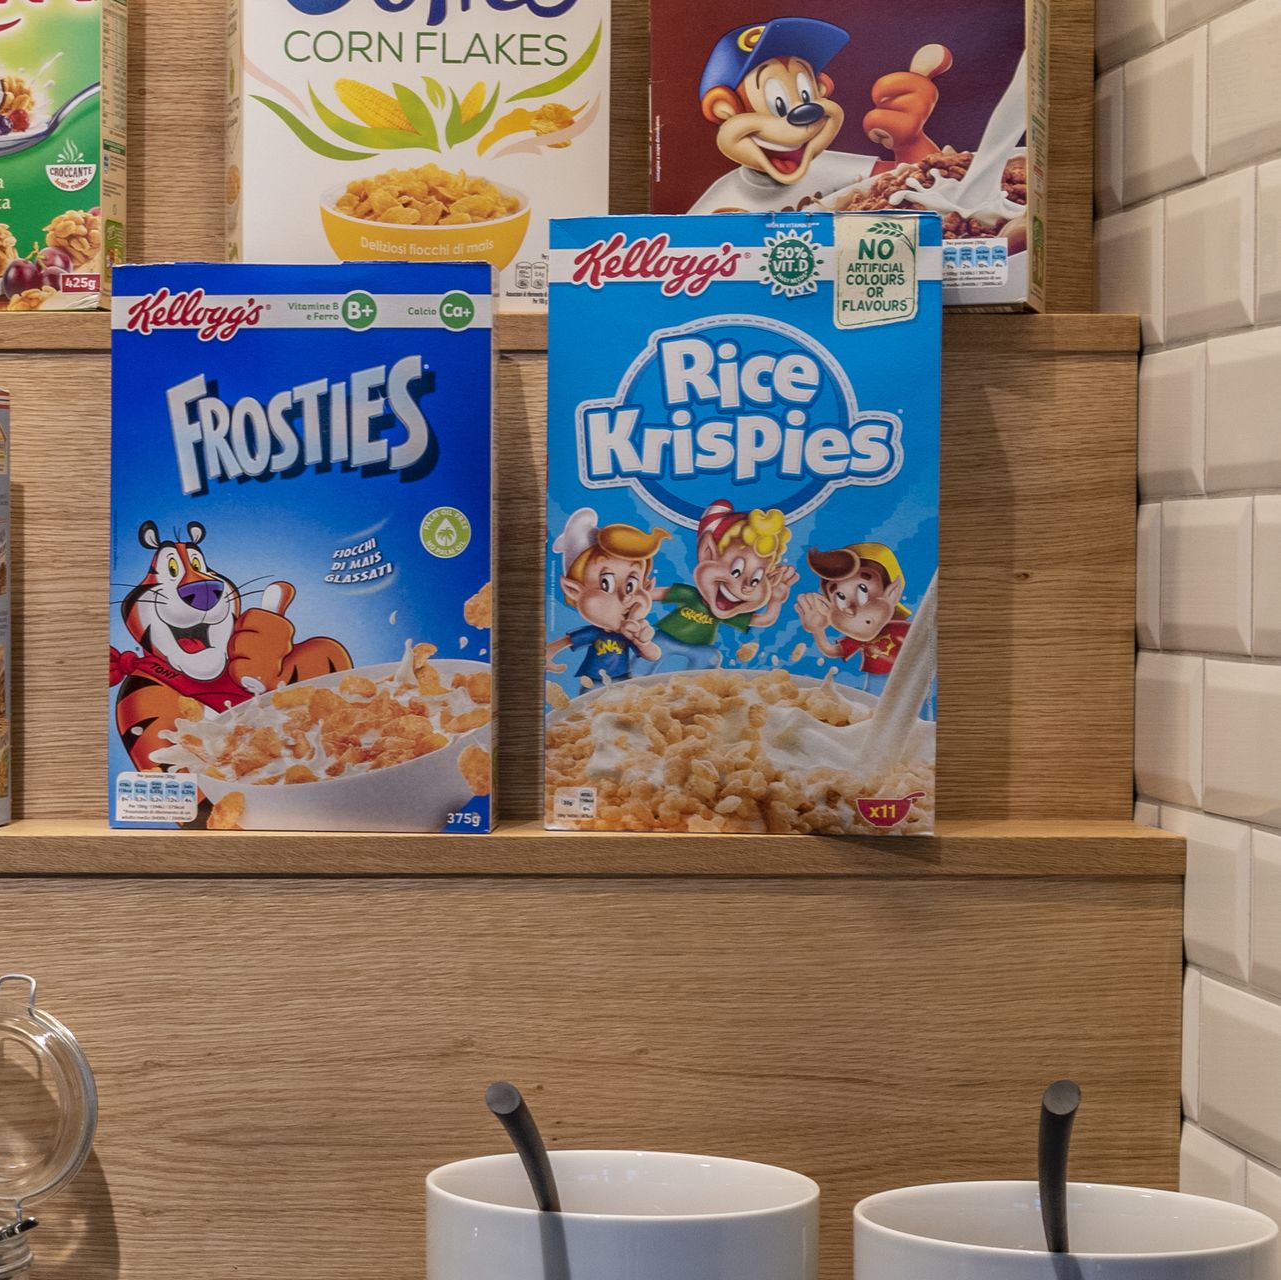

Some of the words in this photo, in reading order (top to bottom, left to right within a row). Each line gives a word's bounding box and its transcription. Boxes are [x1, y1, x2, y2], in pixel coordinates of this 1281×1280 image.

[283, 29, 404, 64] CORN
[417, 32, 568, 67] FLAKES
[49, 166, 93, 178] CROCCANTE
[360, 236, 407, 255] Deliziosi
[409, 243, 450, 256] fiocchi
[452, 244, 464, 255] di
[466, 239, 495, 254] mais
[776, 246, 809, 259] 50%
[858, 238, 895, 260] NO
[573, 233, 742, 295] Kellogg's
[846, 262, 905, 273] ARTIFICIAL
[63, 276, 96, 291] 425g
[845, 273, 906, 286] COLOURS
[866, 286, 884, 298] OR
[287, 302, 330, 311] Vitamine
[333, 302, 339, 310] B
[407, 306, 437, 316] Calcio
[441, 303, 472, 318] Ca+
[842, 299, 908, 312] FLAVOURS
[127, 287, 263, 341] Kellogg's
[313, 312, 339, 321] Ferro
[660, 339, 820, 409] Rice
[166, 355, 429, 496] FROSTIES
[587, 409, 893, 480] Krispies
[332, 537, 377, 559] FIOCCHI
[331, 561, 346, 571] DI
[349, 551, 382, 570] MAIS
[324, 562, 393, 584] GLASSATI
[149, 662, 181, 680] TONY
[446, 811, 482, 827] 375g
[869, 803, 897, 819] x11
